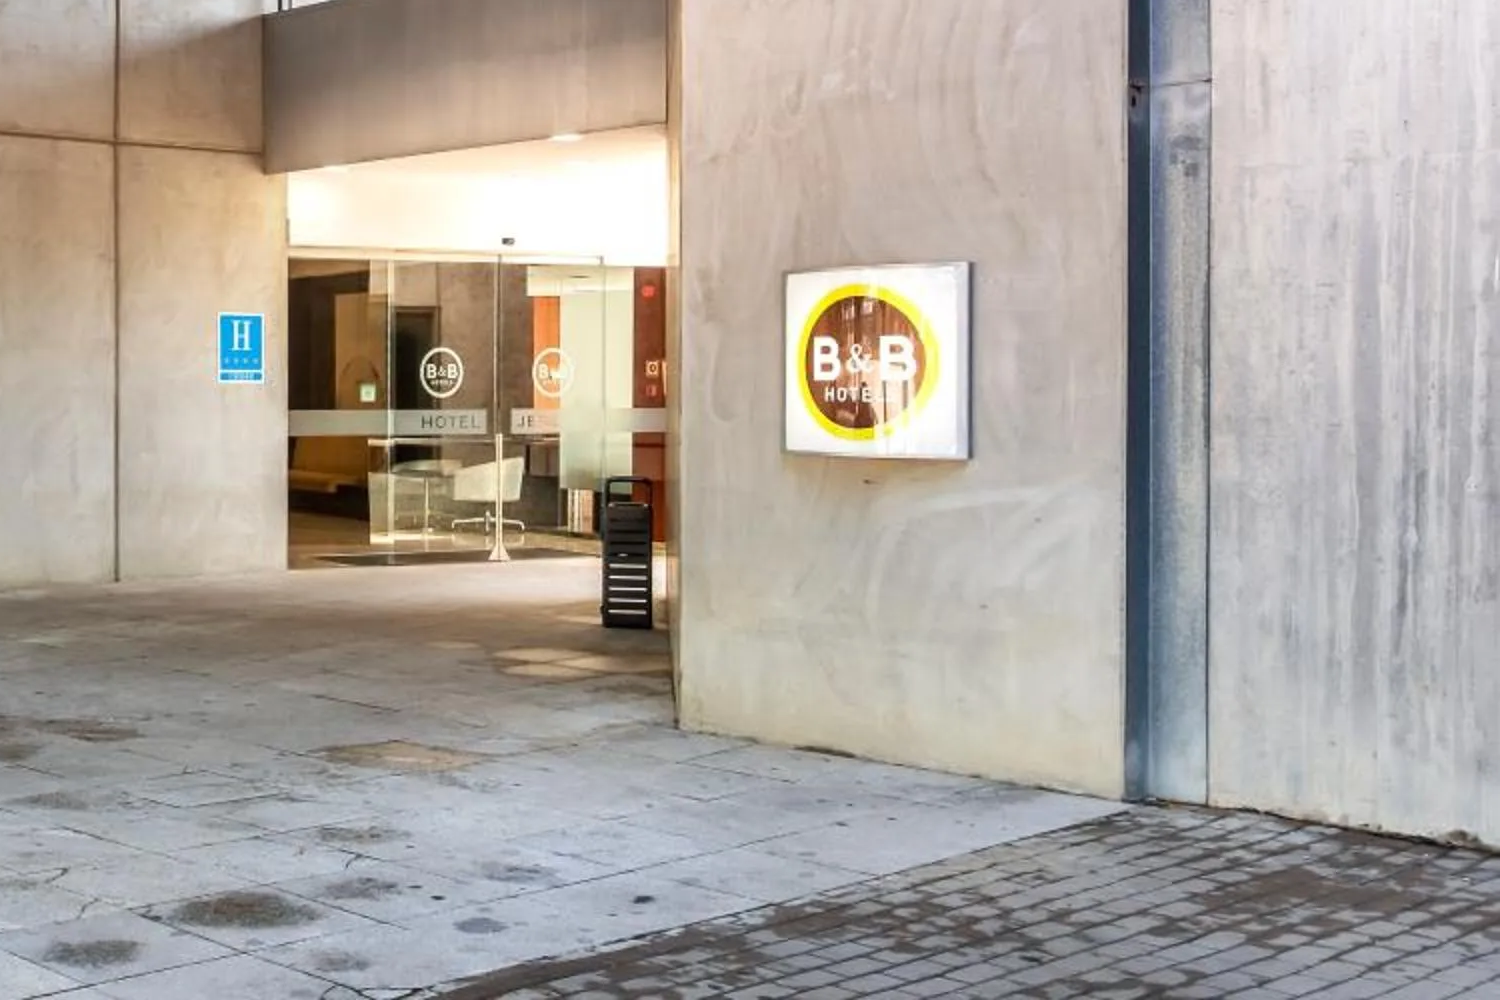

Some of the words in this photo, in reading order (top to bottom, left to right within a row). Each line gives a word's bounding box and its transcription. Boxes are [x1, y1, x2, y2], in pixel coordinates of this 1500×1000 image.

[230, 319, 253, 351] H
[813, 335, 917, 381] B&B
[426, 363, 458, 379] B&B
[421, 415, 481, 429] HOTEL
